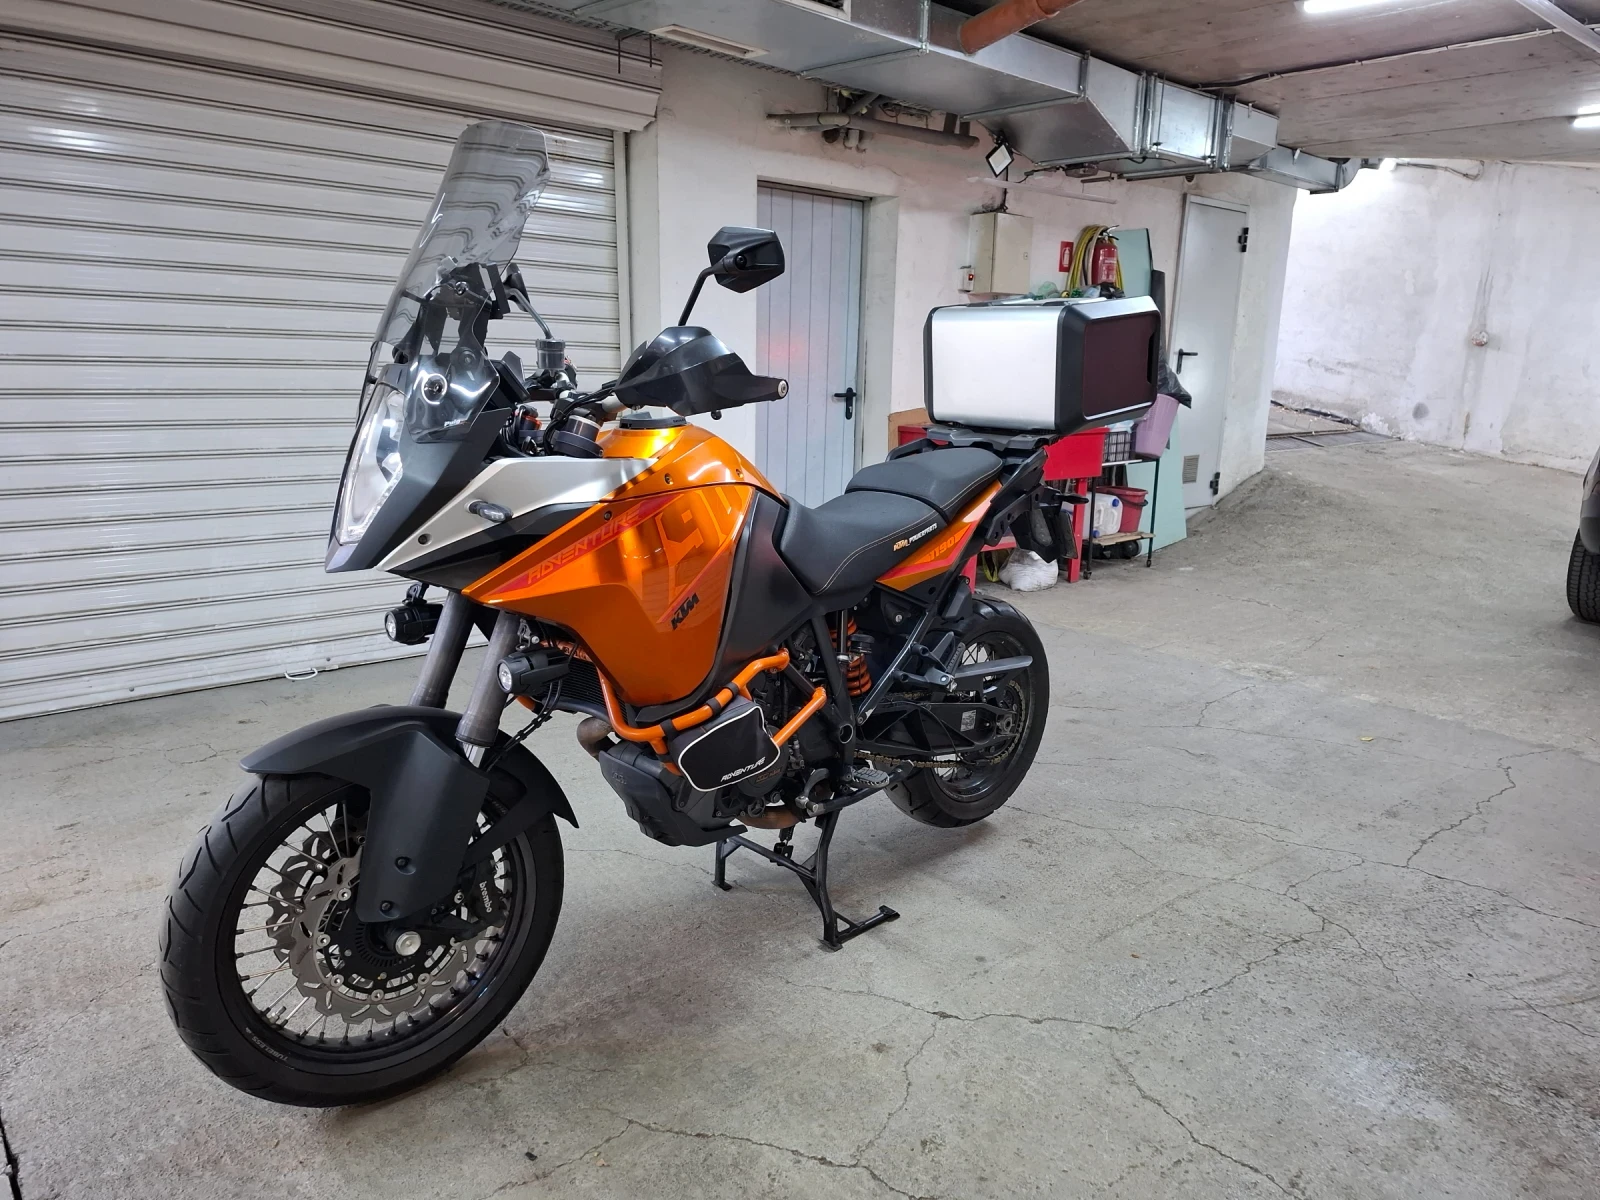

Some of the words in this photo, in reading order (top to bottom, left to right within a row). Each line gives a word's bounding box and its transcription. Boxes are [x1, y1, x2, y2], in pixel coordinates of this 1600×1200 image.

[527, 503, 642, 584] ADVENTURE
[671, 592, 700, 631] KTM
[720, 756, 766, 782] ADVENTURE
[479, 880, 493, 913] brembo
